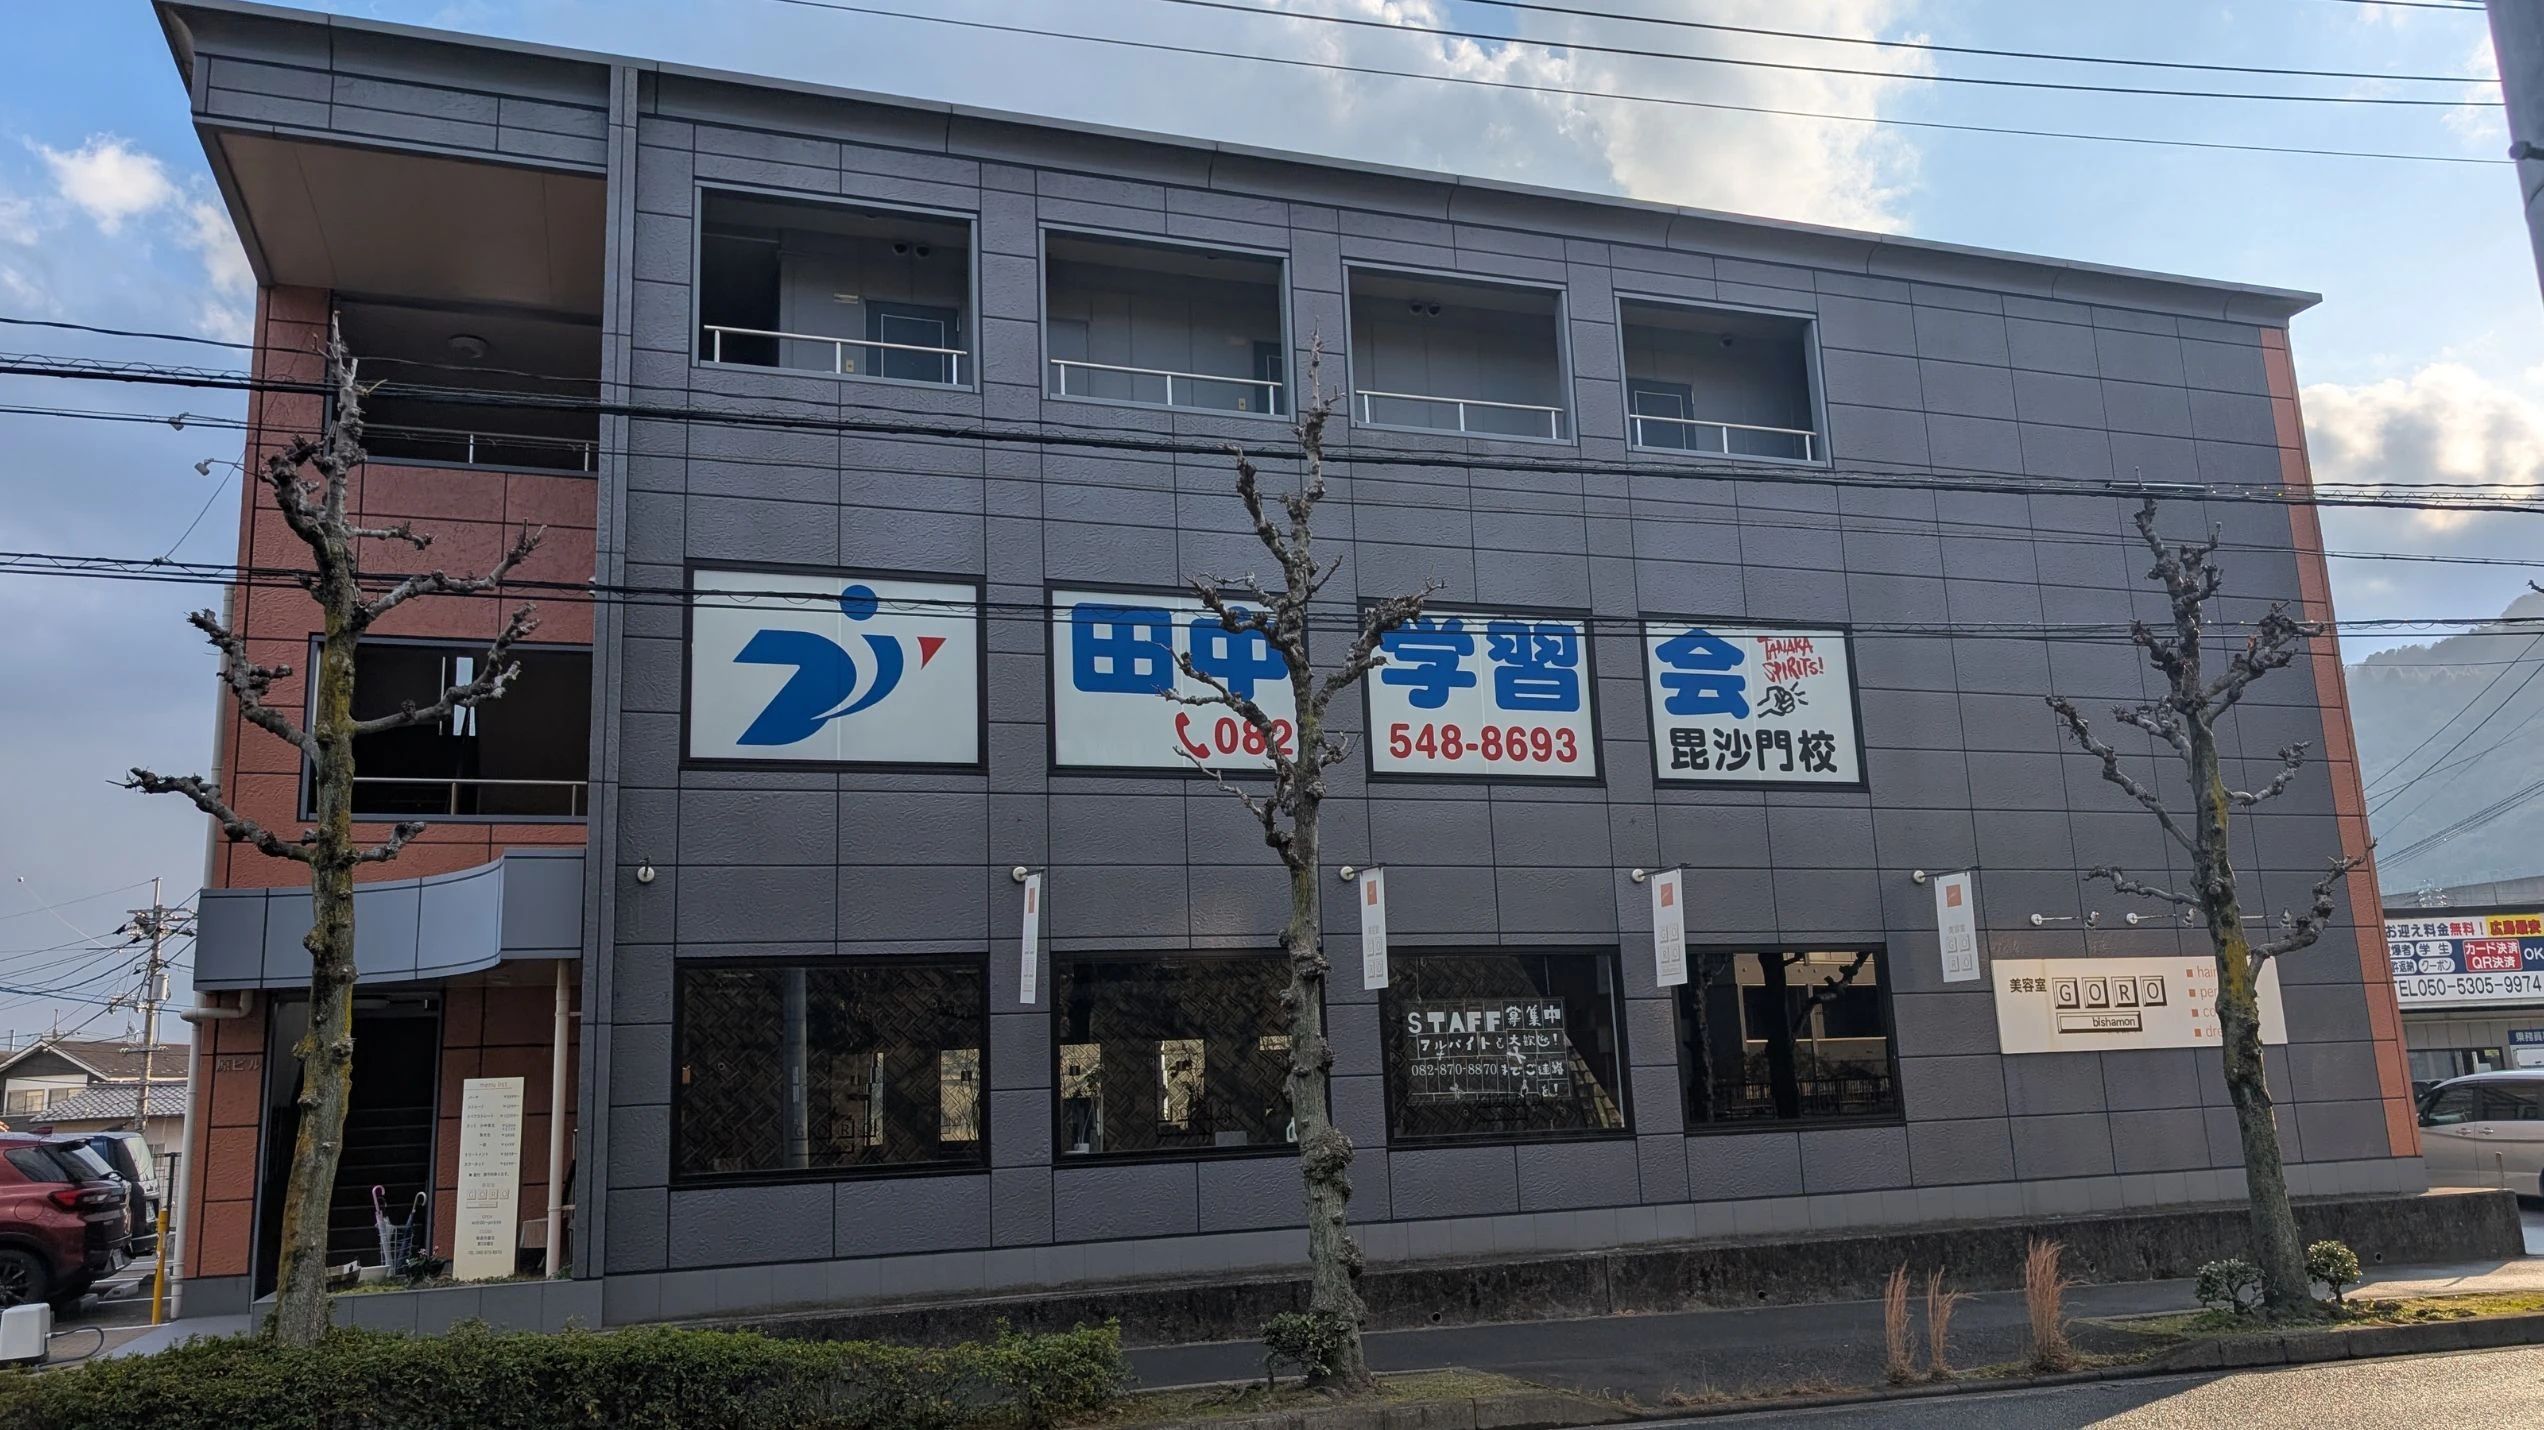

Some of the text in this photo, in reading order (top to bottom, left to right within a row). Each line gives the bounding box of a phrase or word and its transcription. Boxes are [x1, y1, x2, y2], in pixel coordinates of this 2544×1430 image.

[1072, 602, 1750, 720] 田中 学習 会
[1757, 636, 1814, 661] TANAKA
[1762, 656, 1824, 685] SPIRITS!
[1214, 717, 1578, 763] 082 548-8693
[1669, 727, 1837, 773] 毘沙門校
[2465, 941, 2518, 955] カード決済
[2421, 959, 2452, 972] クーポン
[2472, 955, 2516, 969] QR決済
[2010, 977, 2159, 1002] 美容室 GORO
[2093, 1016, 2136, 1028] bishamon
